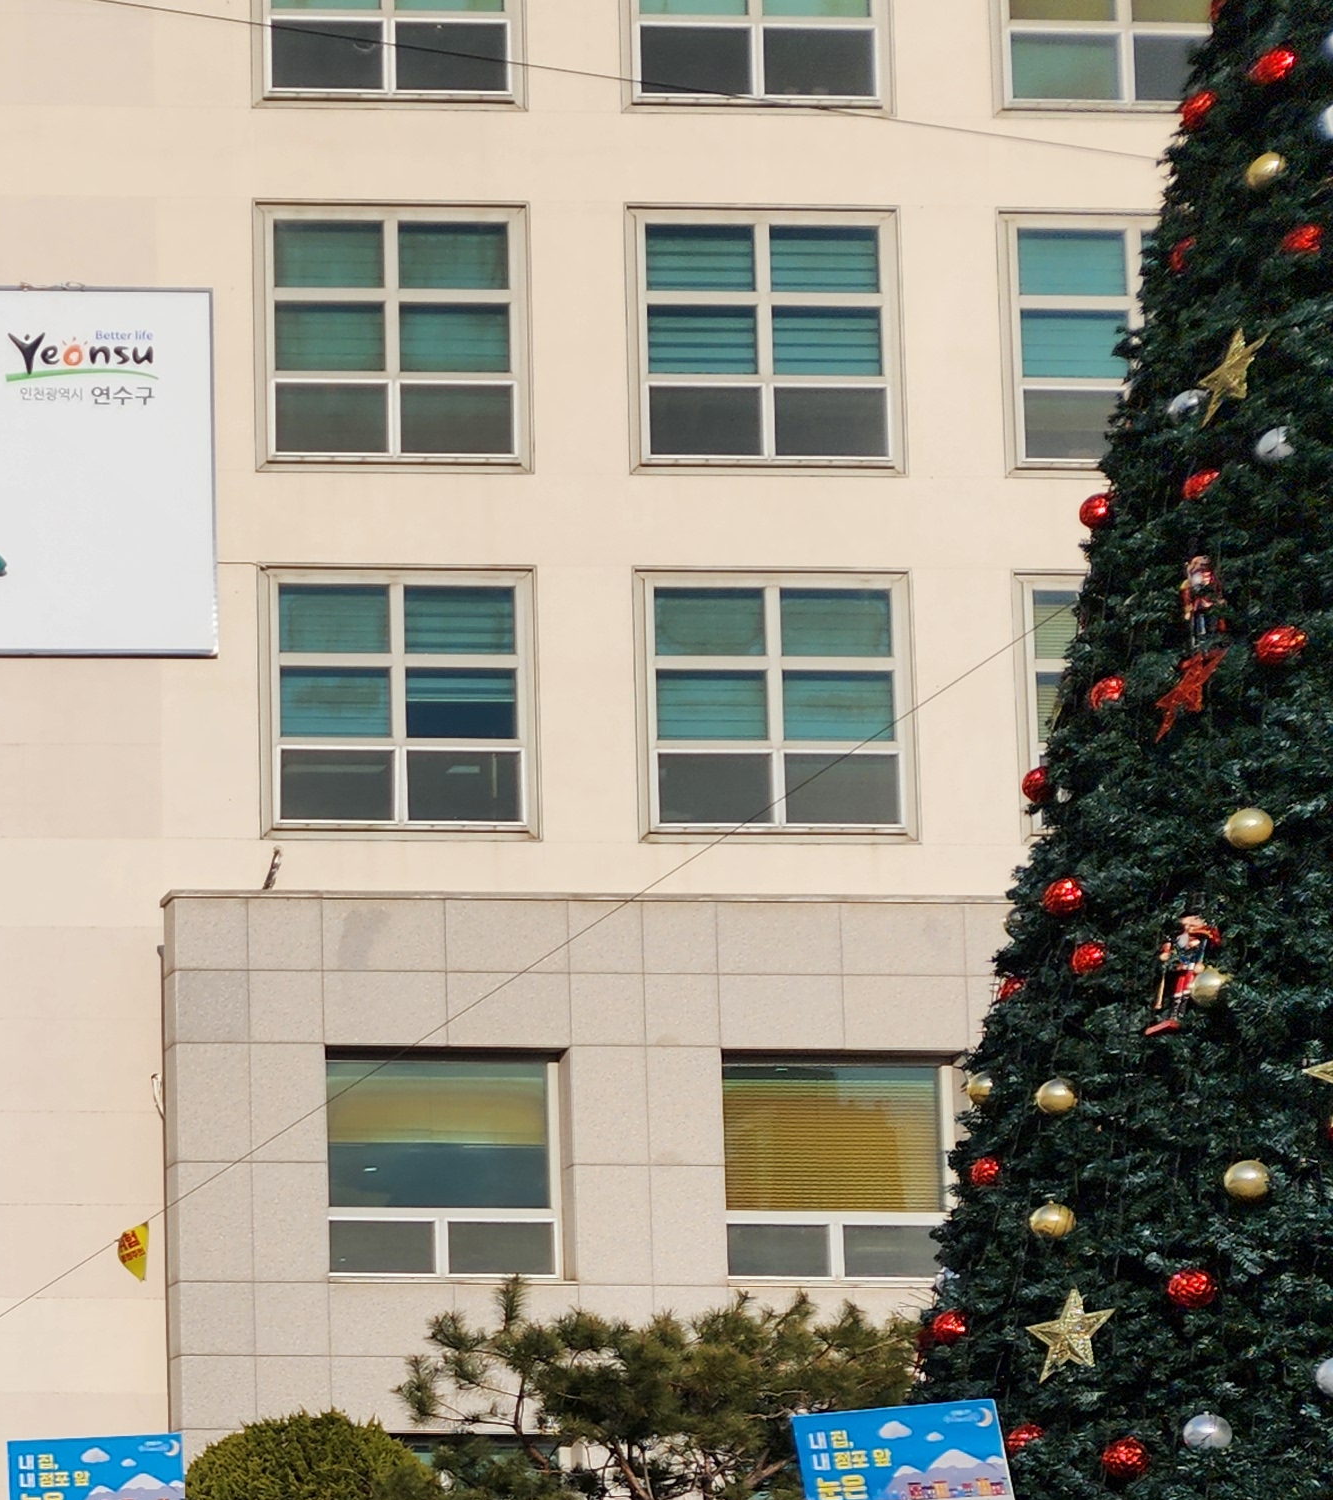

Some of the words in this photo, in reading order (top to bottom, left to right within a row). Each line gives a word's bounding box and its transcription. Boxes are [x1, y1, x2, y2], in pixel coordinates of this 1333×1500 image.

[95, 330, 132, 341] Better
[135, 330, 153, 340] life
[8, 332, 153, 375] Yeonsu
[20, 387, 83, 401] 인천광역시
[90, 386, 155, 405] 연수구
[808, 1431, 828, 1450] 내
[830, 1429, 855, 1450] 집,
[18, 1454, 34, 1470] 내
[38, 1453, 58, 1470] 집,
[812, 1452, 831, 1471] 내
[833, 1449, 870, 1470] 점포
[872, 1447, 894, 1467] 앞
[19, 1472, 35, 1488] 내
[39, 1471, 69, 1488] 점포
[73, 1470, 90, 1486] 앞
